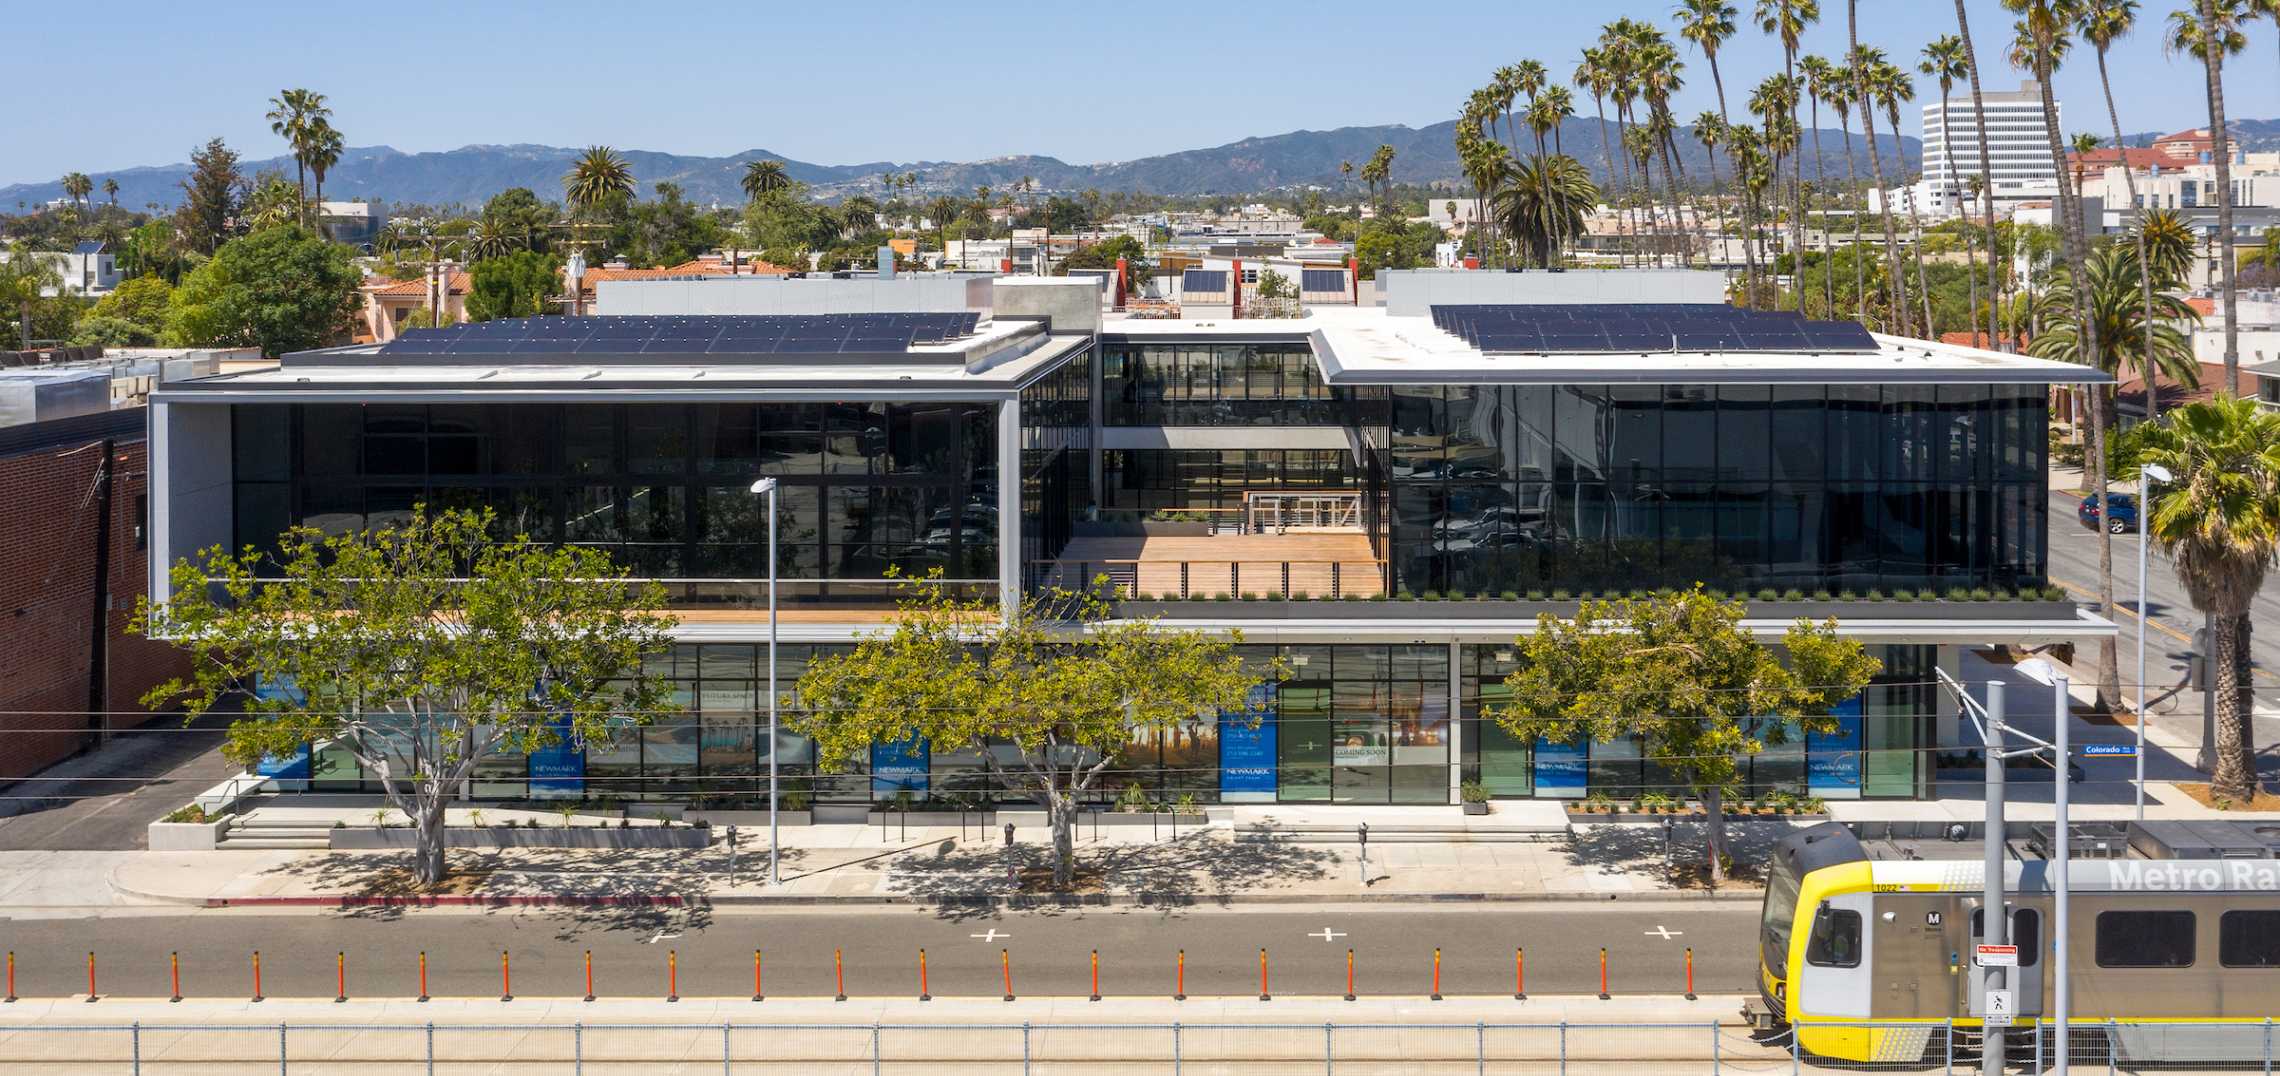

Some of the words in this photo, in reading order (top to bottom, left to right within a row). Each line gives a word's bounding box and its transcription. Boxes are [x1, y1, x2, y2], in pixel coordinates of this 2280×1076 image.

[2086, 745, 2120, 753] Colorado
[2108, 860, 2221, 890] Metro
[1876, 884, 1897, 892] 1022
